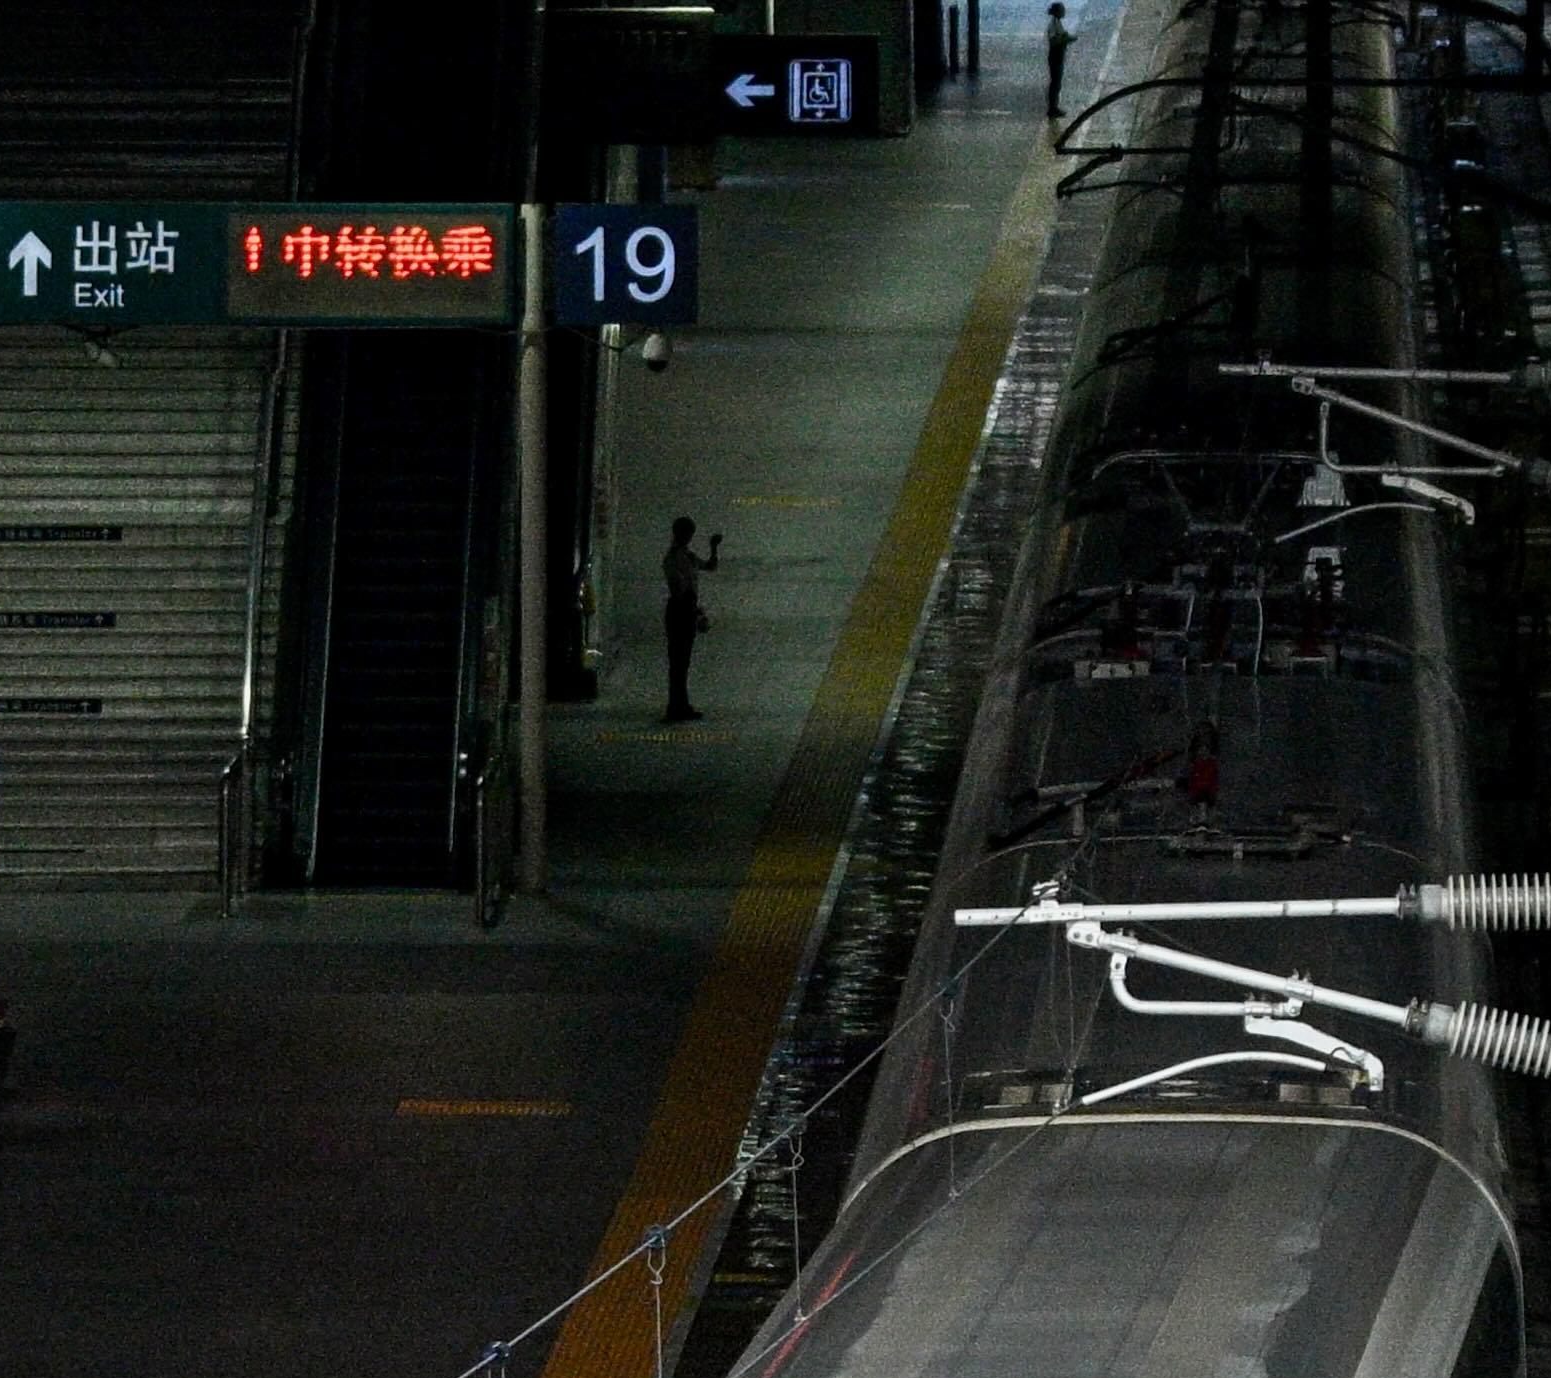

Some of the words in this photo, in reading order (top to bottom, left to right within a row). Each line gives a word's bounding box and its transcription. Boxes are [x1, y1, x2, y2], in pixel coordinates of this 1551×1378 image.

[74, 221, 179, 275] 出站
[576, 226, 675, 302] 19
[74, 282, 125, 307] Exit
